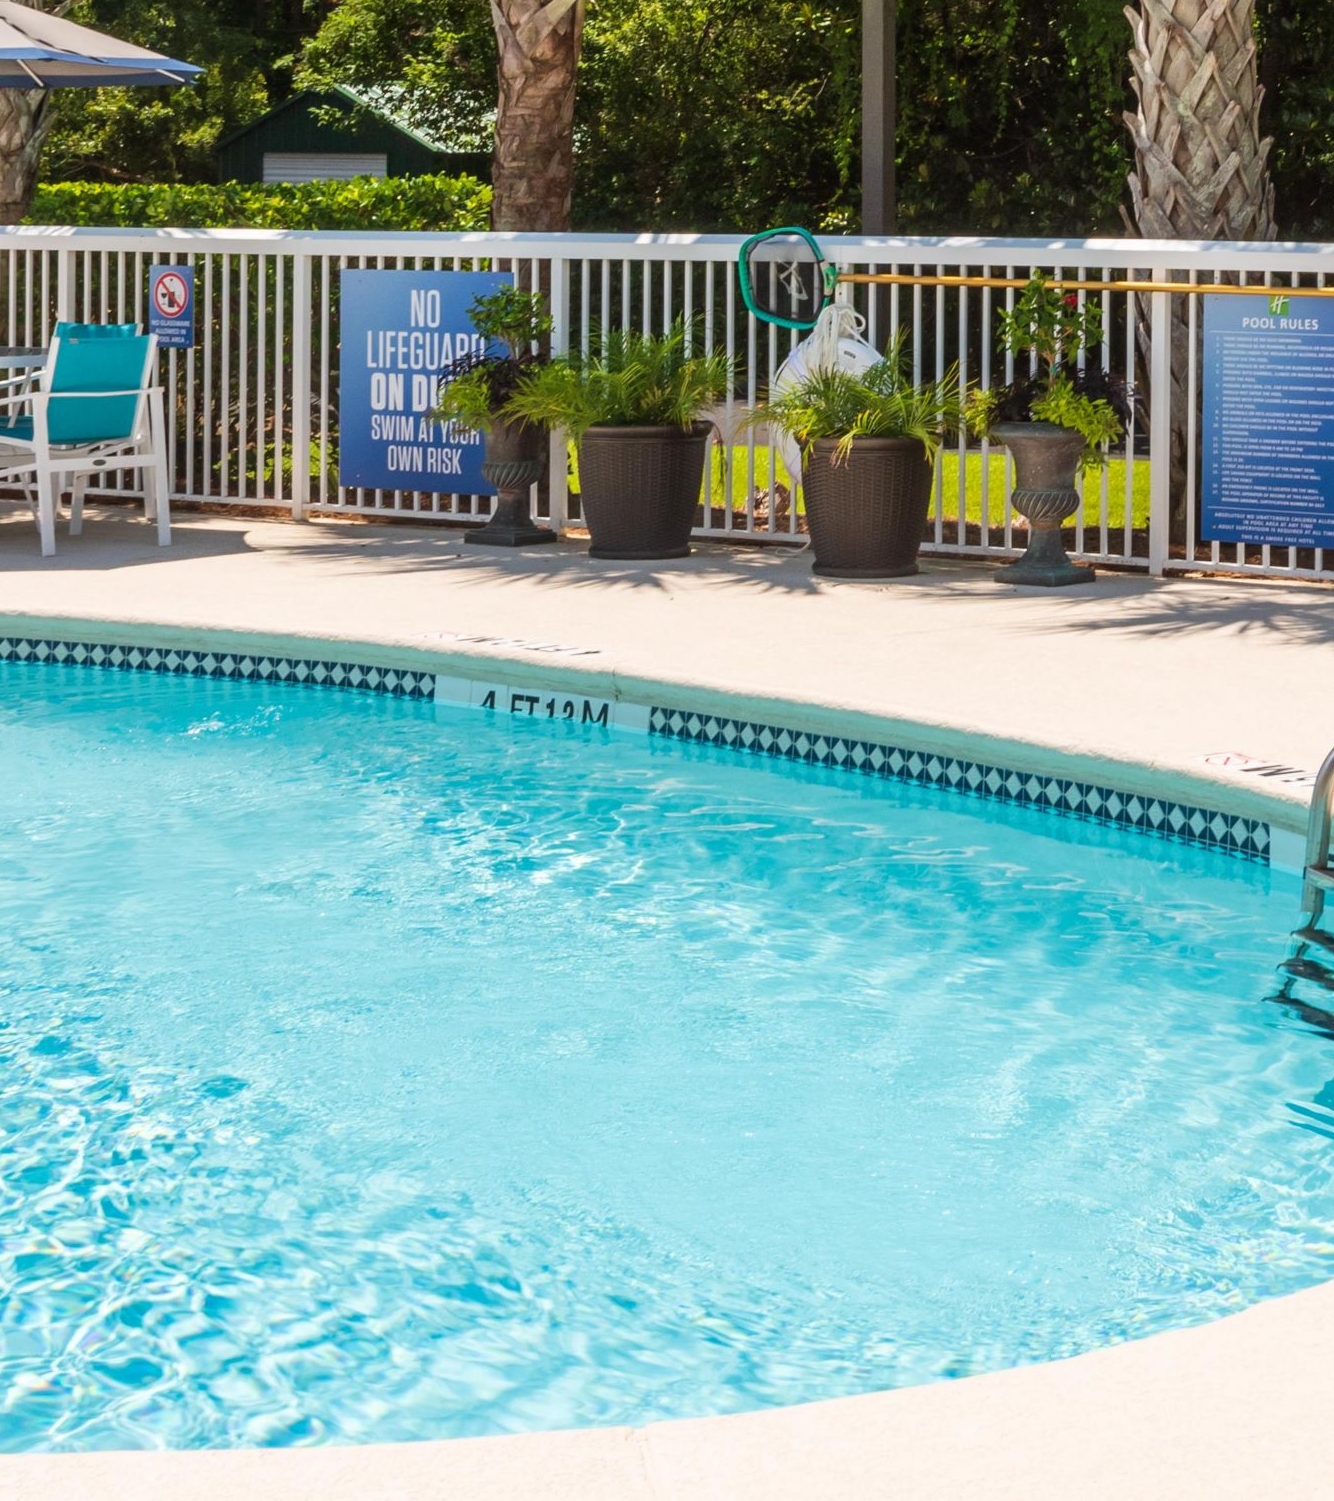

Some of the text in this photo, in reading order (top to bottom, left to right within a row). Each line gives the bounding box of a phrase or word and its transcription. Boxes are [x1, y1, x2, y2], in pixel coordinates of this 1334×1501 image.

[410, 289, 441, 328] NO
[1242, 317, 1319, 331] POOL RULES
[370, 372, 404, 411] ON
[371, 414, 414, 441] SWIM
[387, 445, 462, 475] OWN RISK
[511, 694, 540, 716] FT
[582, 700, 609, 728] M
